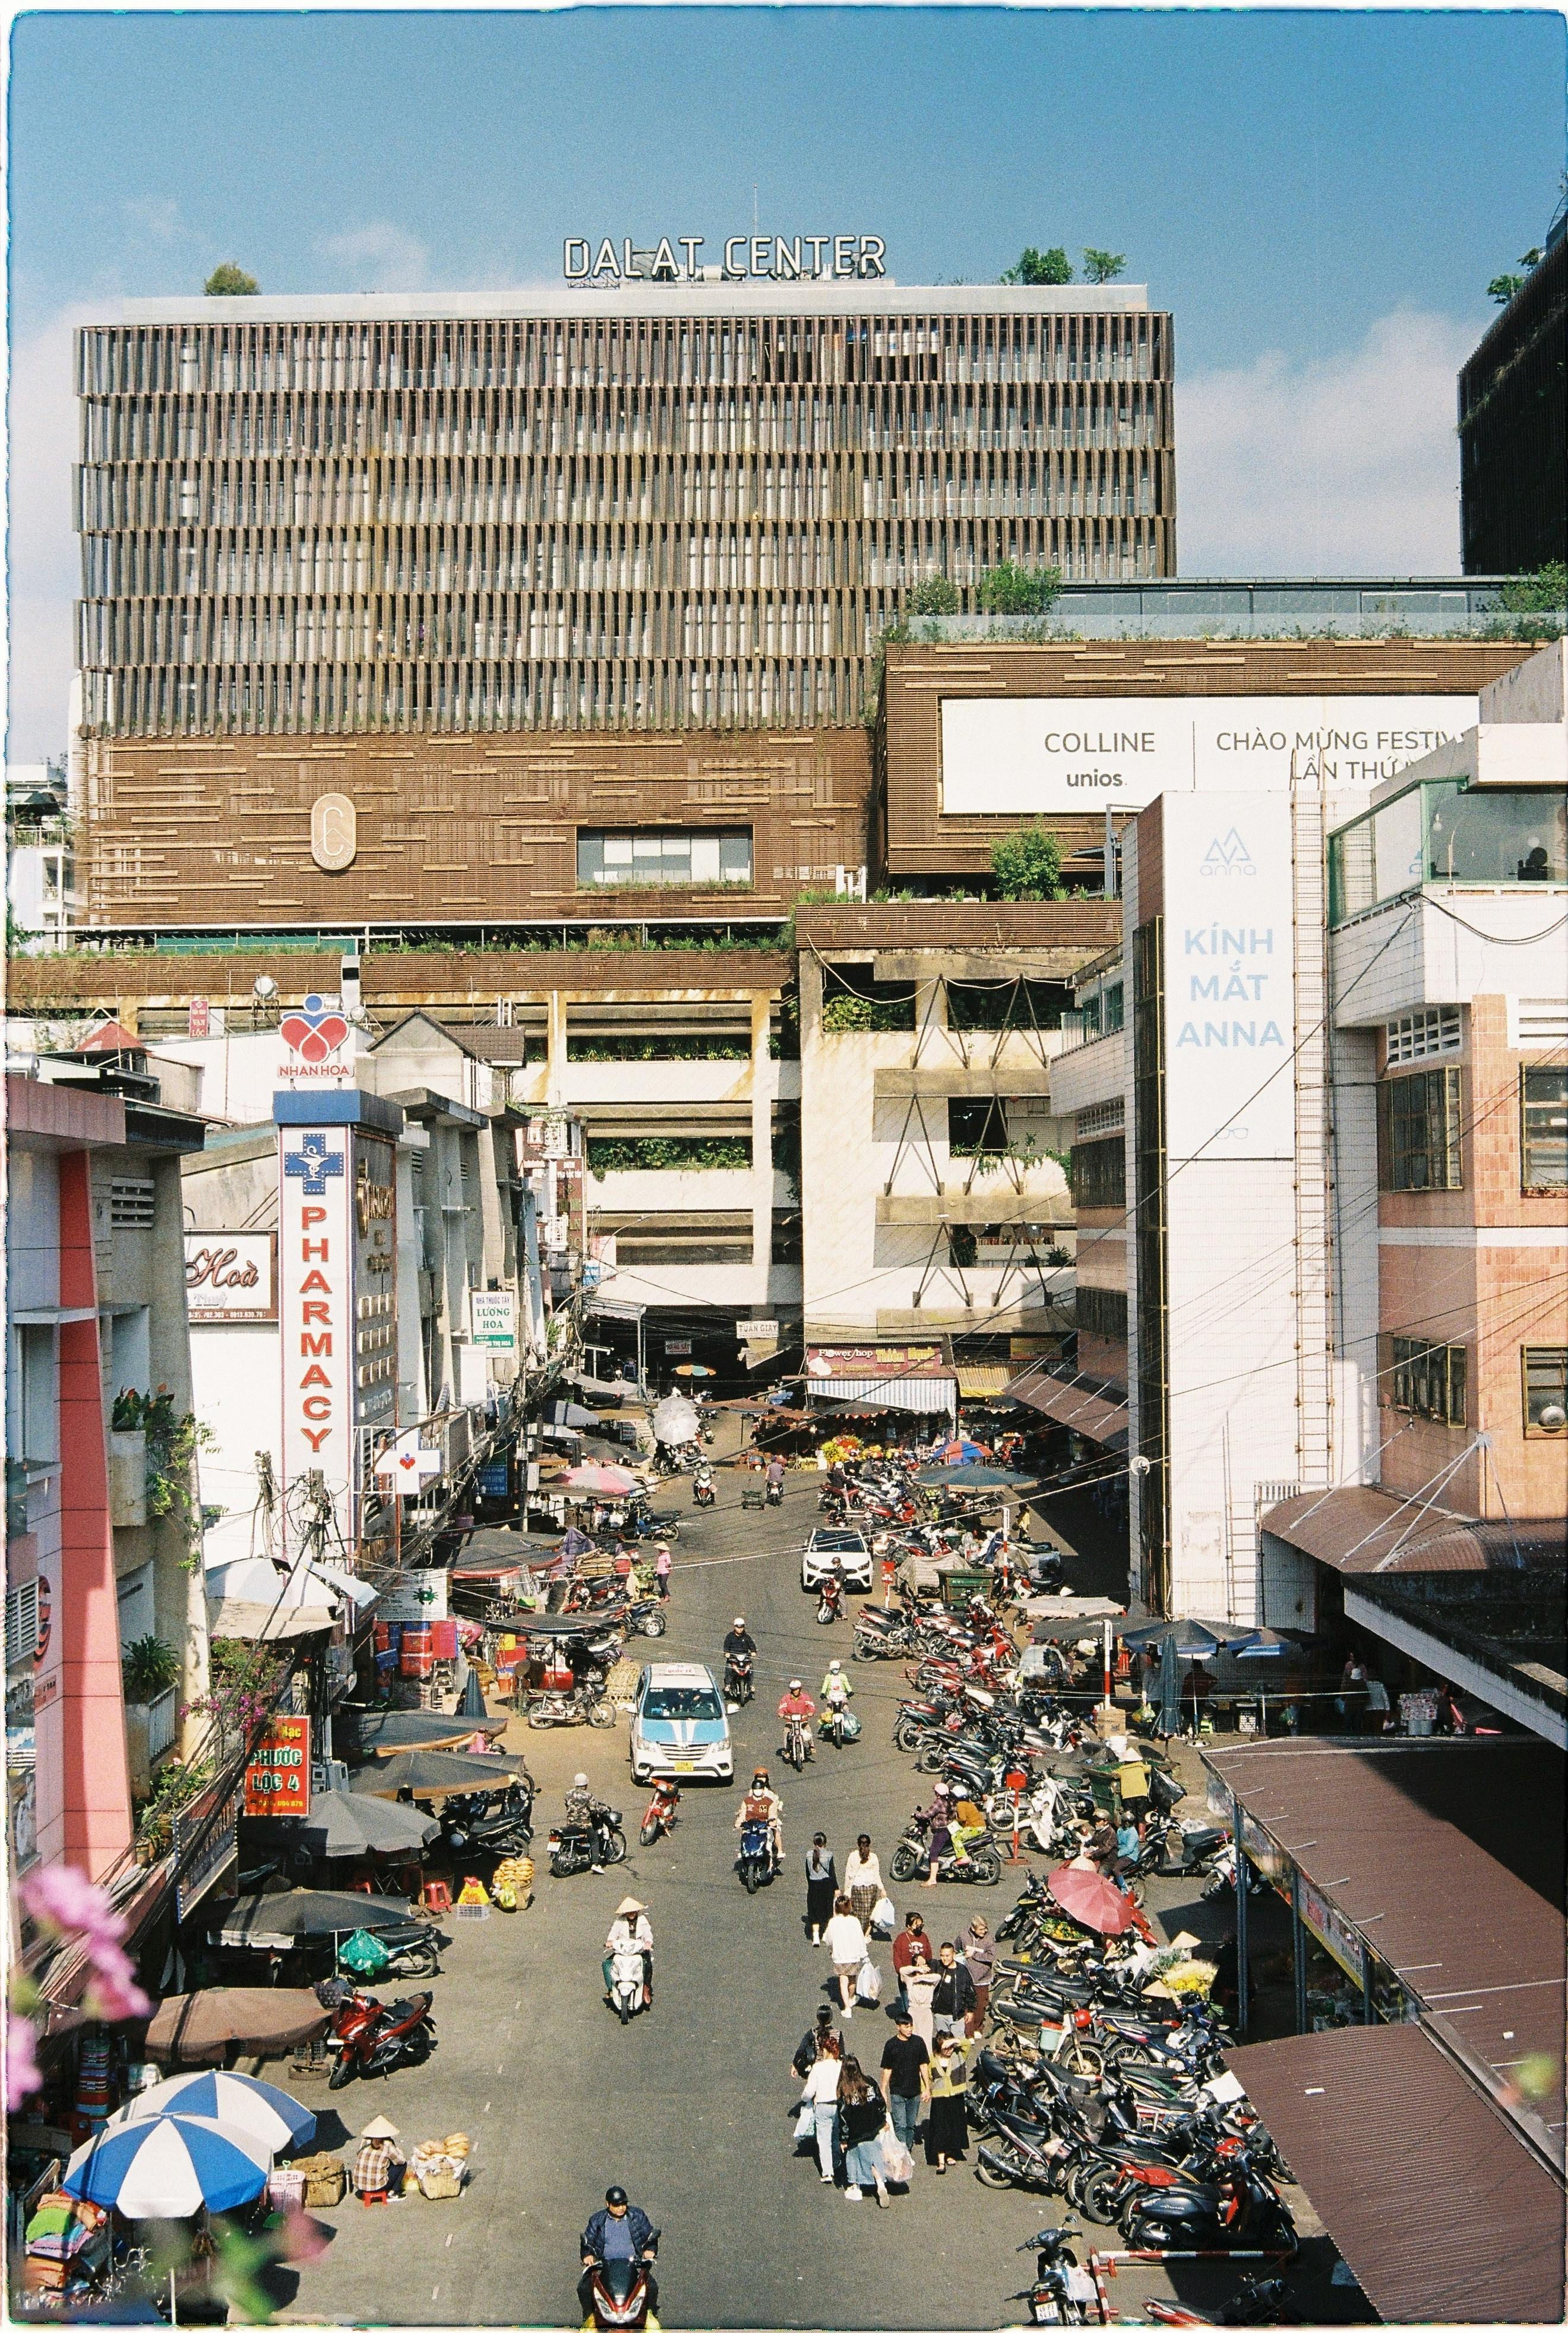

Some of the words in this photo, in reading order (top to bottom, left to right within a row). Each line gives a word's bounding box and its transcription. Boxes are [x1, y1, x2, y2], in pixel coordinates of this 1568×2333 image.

[564, 237, 704, 279] DALAT
[723, 235, 887, 278] CENTER
[1044, 732, 1155, 753] COLLINE
[1216, 727, 1286, 750] CHÀO
[1295, 726, 1368, 750] MỪNG
[1199, 864, 1257, 877] anna
[1184, 922, 1274, 956] KÍNH
[1190, 959, 1269, 1002] MẮT
[1175, 1020, 1285, 1048] ANNA
[299, 1206, 333, 1453] PHARMACY
[249, 1746, 303, 1767] PHƯỚC
[252, 1771, 283, 1794] LỘC
[287, 1774, 301, 1792] 4
